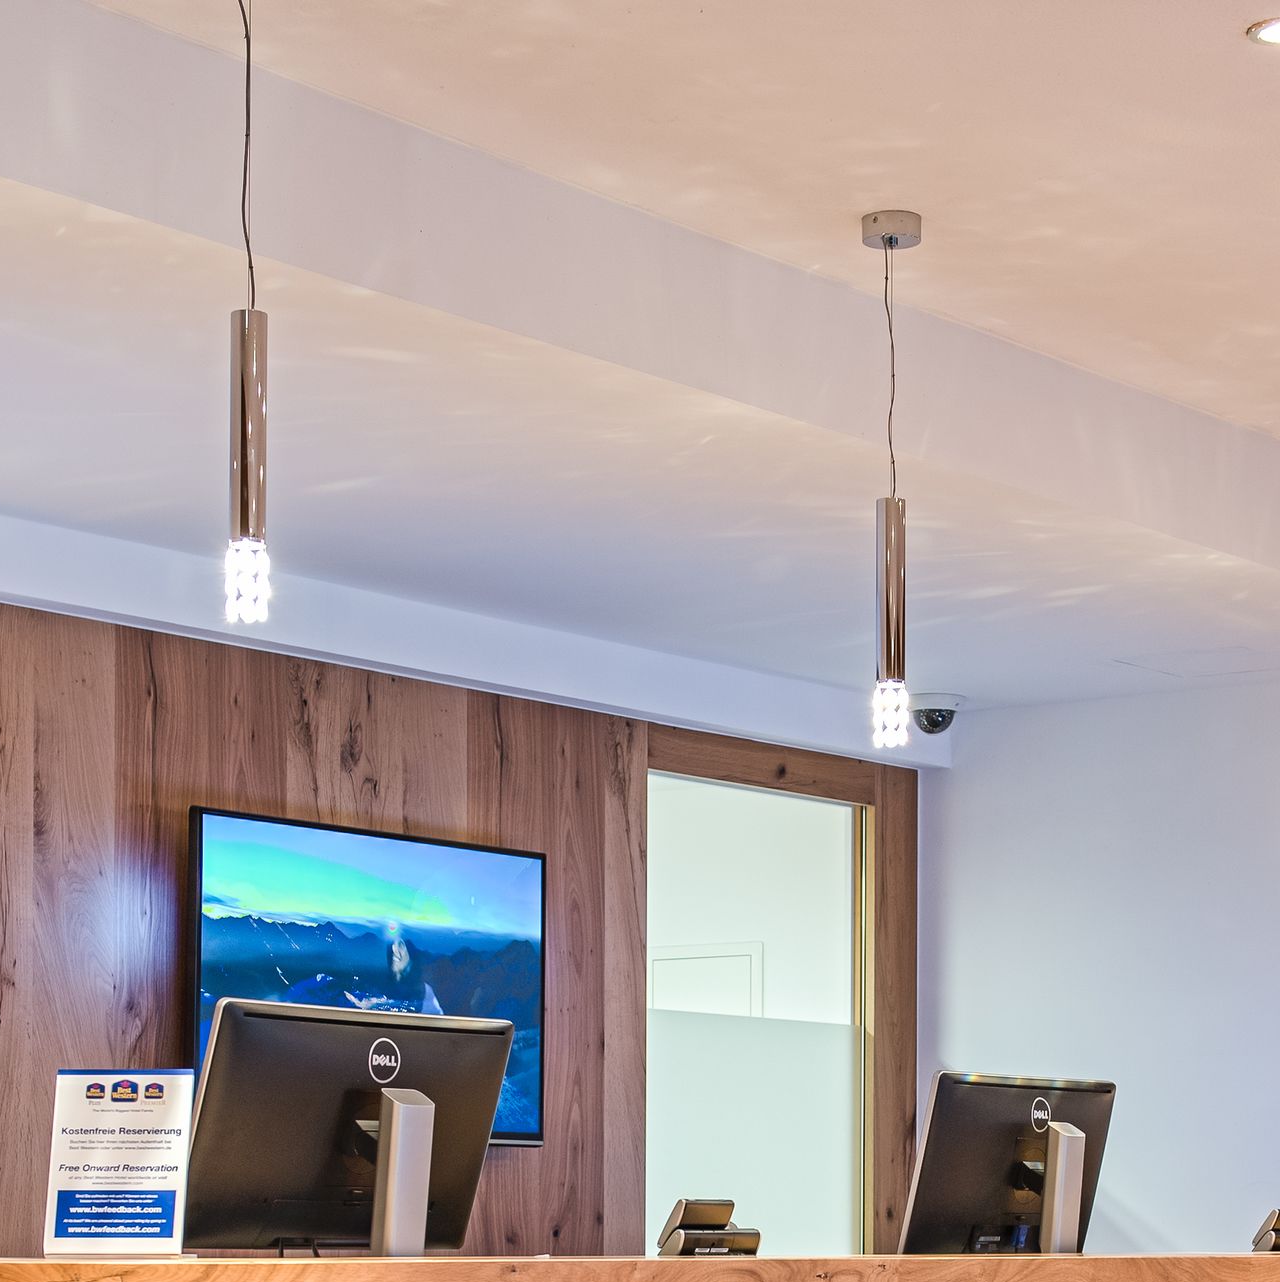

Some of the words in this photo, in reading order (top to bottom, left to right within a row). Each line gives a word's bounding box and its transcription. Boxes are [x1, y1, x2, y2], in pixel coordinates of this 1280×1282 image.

[372, 1054, 397, 1066] DELL
[1033, 1110, 1048, 1119] DELL
[61, 1127, 116, 1135] Kostenfreie
[118, 1127, 182, 1136] Reservierung
[58, 1164, 80, 1172] Free
[82, 1164, 120, 1172] Onward
[121, 1164, 178, 1172] Reservation
[67, 1225, 160, 1233] www.bwfeedback.com
